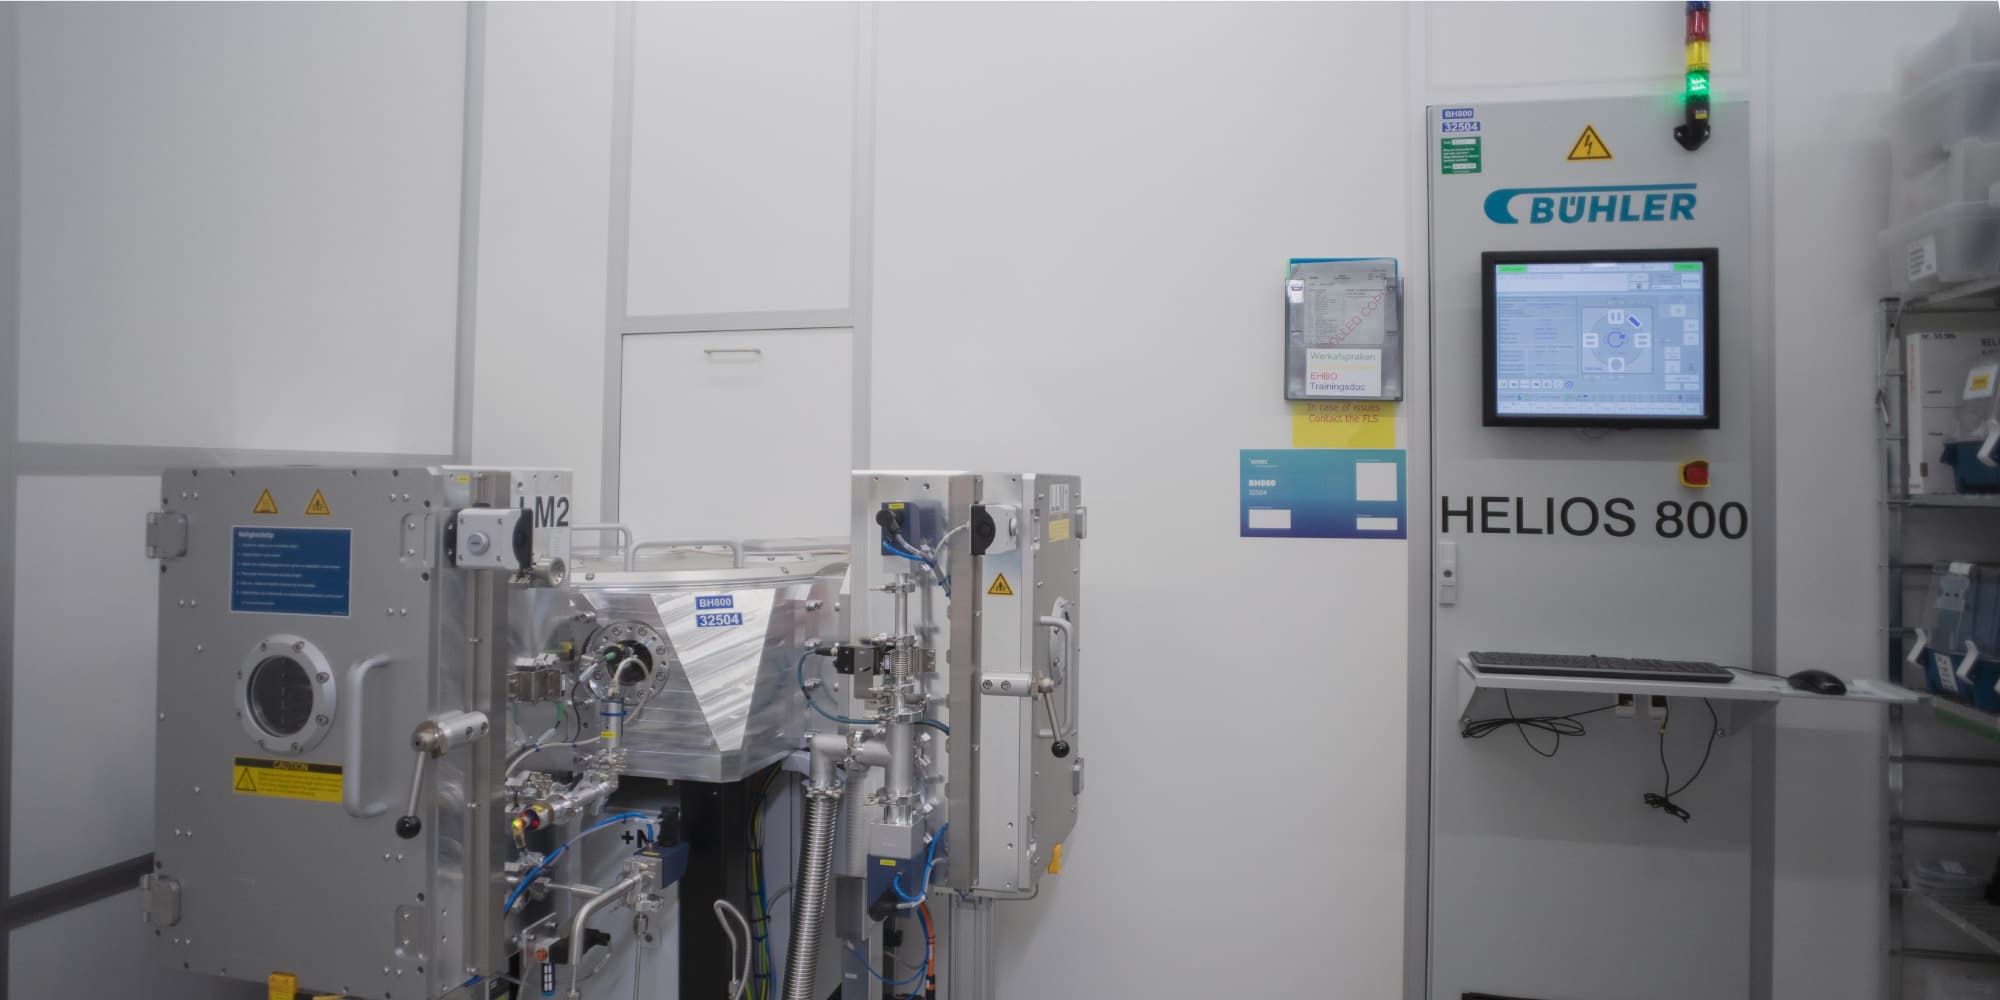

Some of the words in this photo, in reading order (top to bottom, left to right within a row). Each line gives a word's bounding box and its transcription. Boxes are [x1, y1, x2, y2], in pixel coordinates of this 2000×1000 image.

[1445, 122, 1478, 131] 32504
[1529, 193, 1697, 224] BÜHLER
[1310, 352, 1376, 362] Werkafspraken
[1311, 382, 1366, 392] Trainingsdoc
[1308, 415, 1342, 423] Contact
[1345, 415, 1360, 423] the
[1441, 496, 1637, 537] HELIOS
[1655, 500, 1748, 539] 800
[699, 598, 732, 608] BH800
[700, 613, 739, 626] 32504
[272, 760, 309, 772] CAUTION
